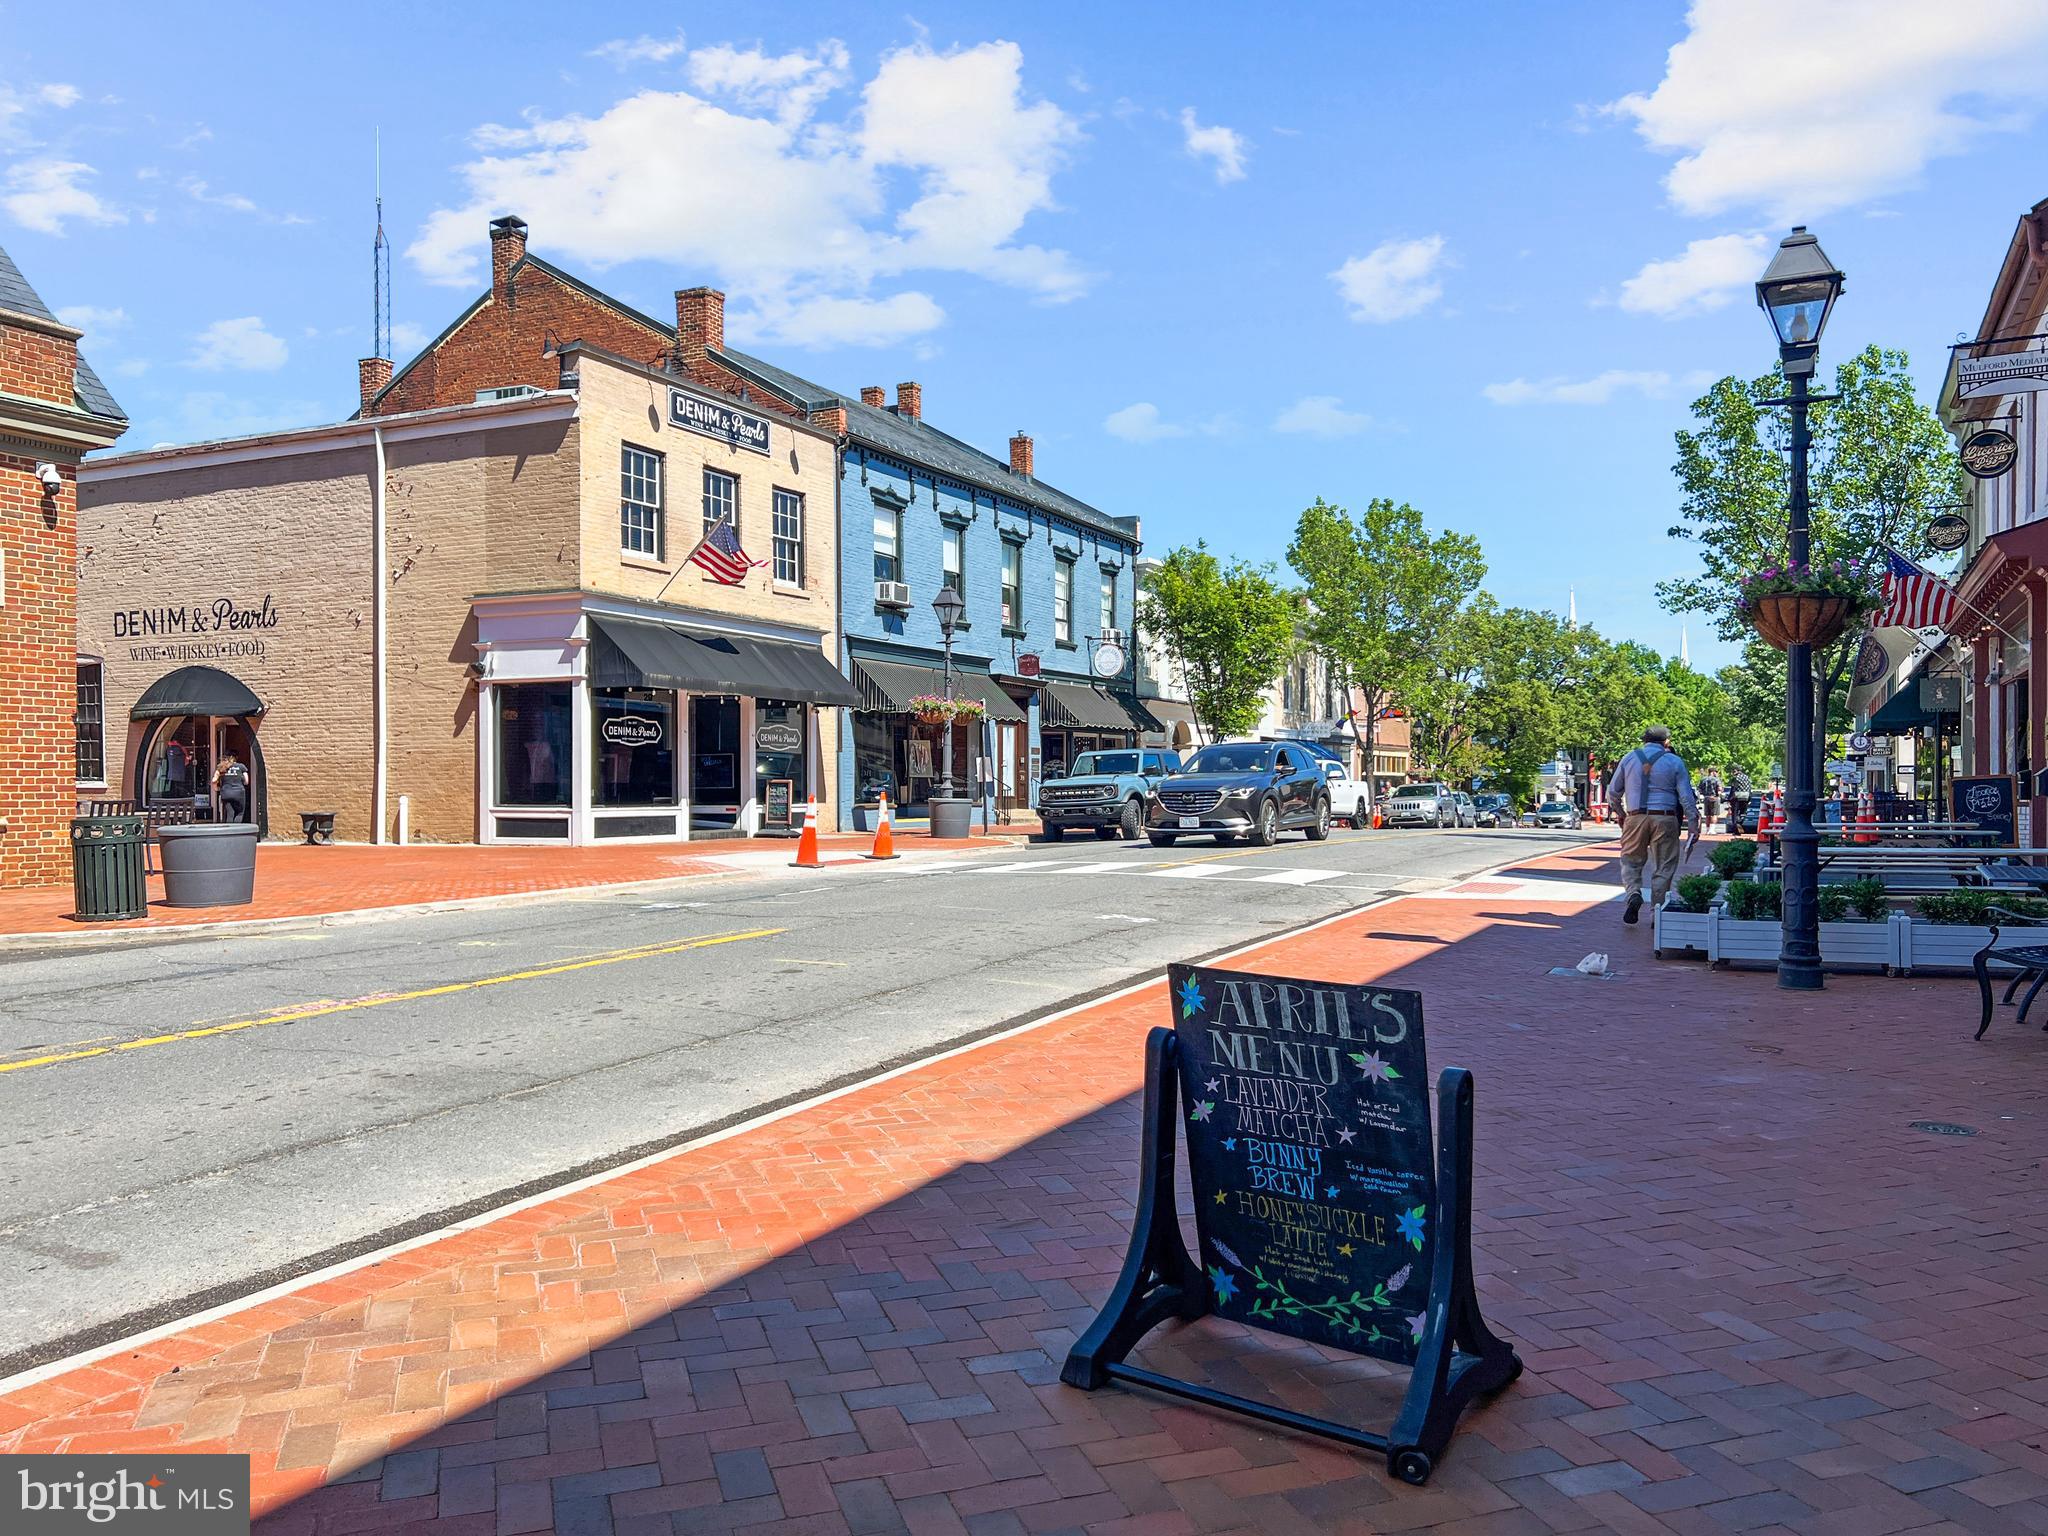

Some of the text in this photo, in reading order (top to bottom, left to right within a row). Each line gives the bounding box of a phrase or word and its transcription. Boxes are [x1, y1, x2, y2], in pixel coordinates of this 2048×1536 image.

[1962, 356, 2048, 373] MULFORD MEDIATI
[676, 395, 765, 441] DENIM & Pearls
[690, 419, 704, 429] WINE
[739, 435, 752, 444] FOOD
[1962, 442, 2016, 462] Licorice
[1973, 454, 2008, 470] Pizza
[1928, 524, 1969, 539] Licorice
[1936, 533, 1962, 545] Pizza
[113, 594, 279, 637] DENIM & Pearls
[129, 639, 265, 662] WINE WHISKEY FOOD
[608, 725, 657, 737] DENIM & Pearls
[760, 733, 779, 742] DENIM
[1210, 980, 1407, 1044] APRIL'S
[1207, 1029, 1340, 1086] MENU
[1220, 1073, 1335, 1119] LAVENDER
[1356, 1097, 1370, 1107] Hot
[1381, 1103, 1400, 1113] Iced
[1359, 1117, 1367, 1125] w/
[1360, 1109, 1391, 1121] matcha
[1236, 1106, 1331, 1148] MATCHA
[1243, 1138, 1322, 1176] BUNNY
[1344, 1160, 1364, 1172] Iced
[1247, 1166, 1315, 1201] BREW
[1349, 1173, 1358, 1181] w/
[1235, 1190, 1386, 1247] HONEYSUCKLE
[1268, 1222, 1327, 1257] LATTE
[1264, 1245, 1280, 1255] Hot
